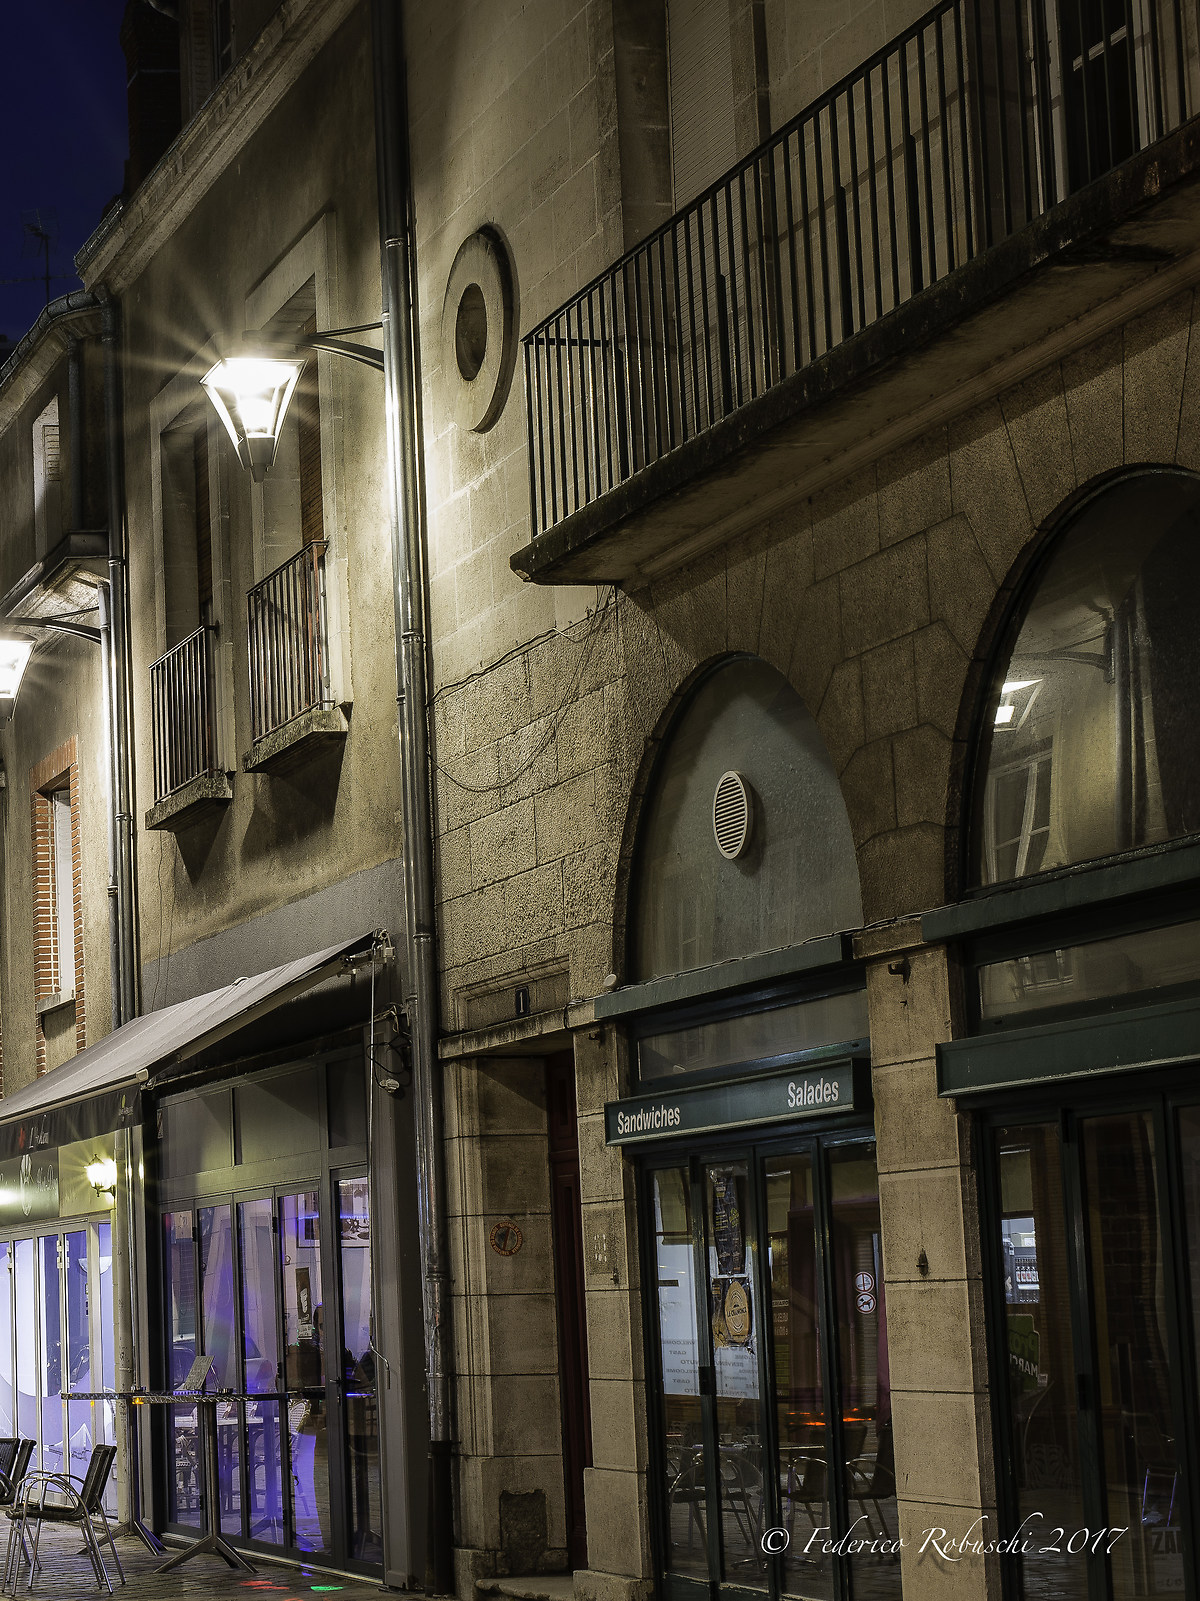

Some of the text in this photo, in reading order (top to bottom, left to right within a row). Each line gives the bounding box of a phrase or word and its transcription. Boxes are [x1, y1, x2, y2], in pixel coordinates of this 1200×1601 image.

[513, 992, 525, 1013] 1
[617, 1077, 839, 1135] Sandwiches Salades
